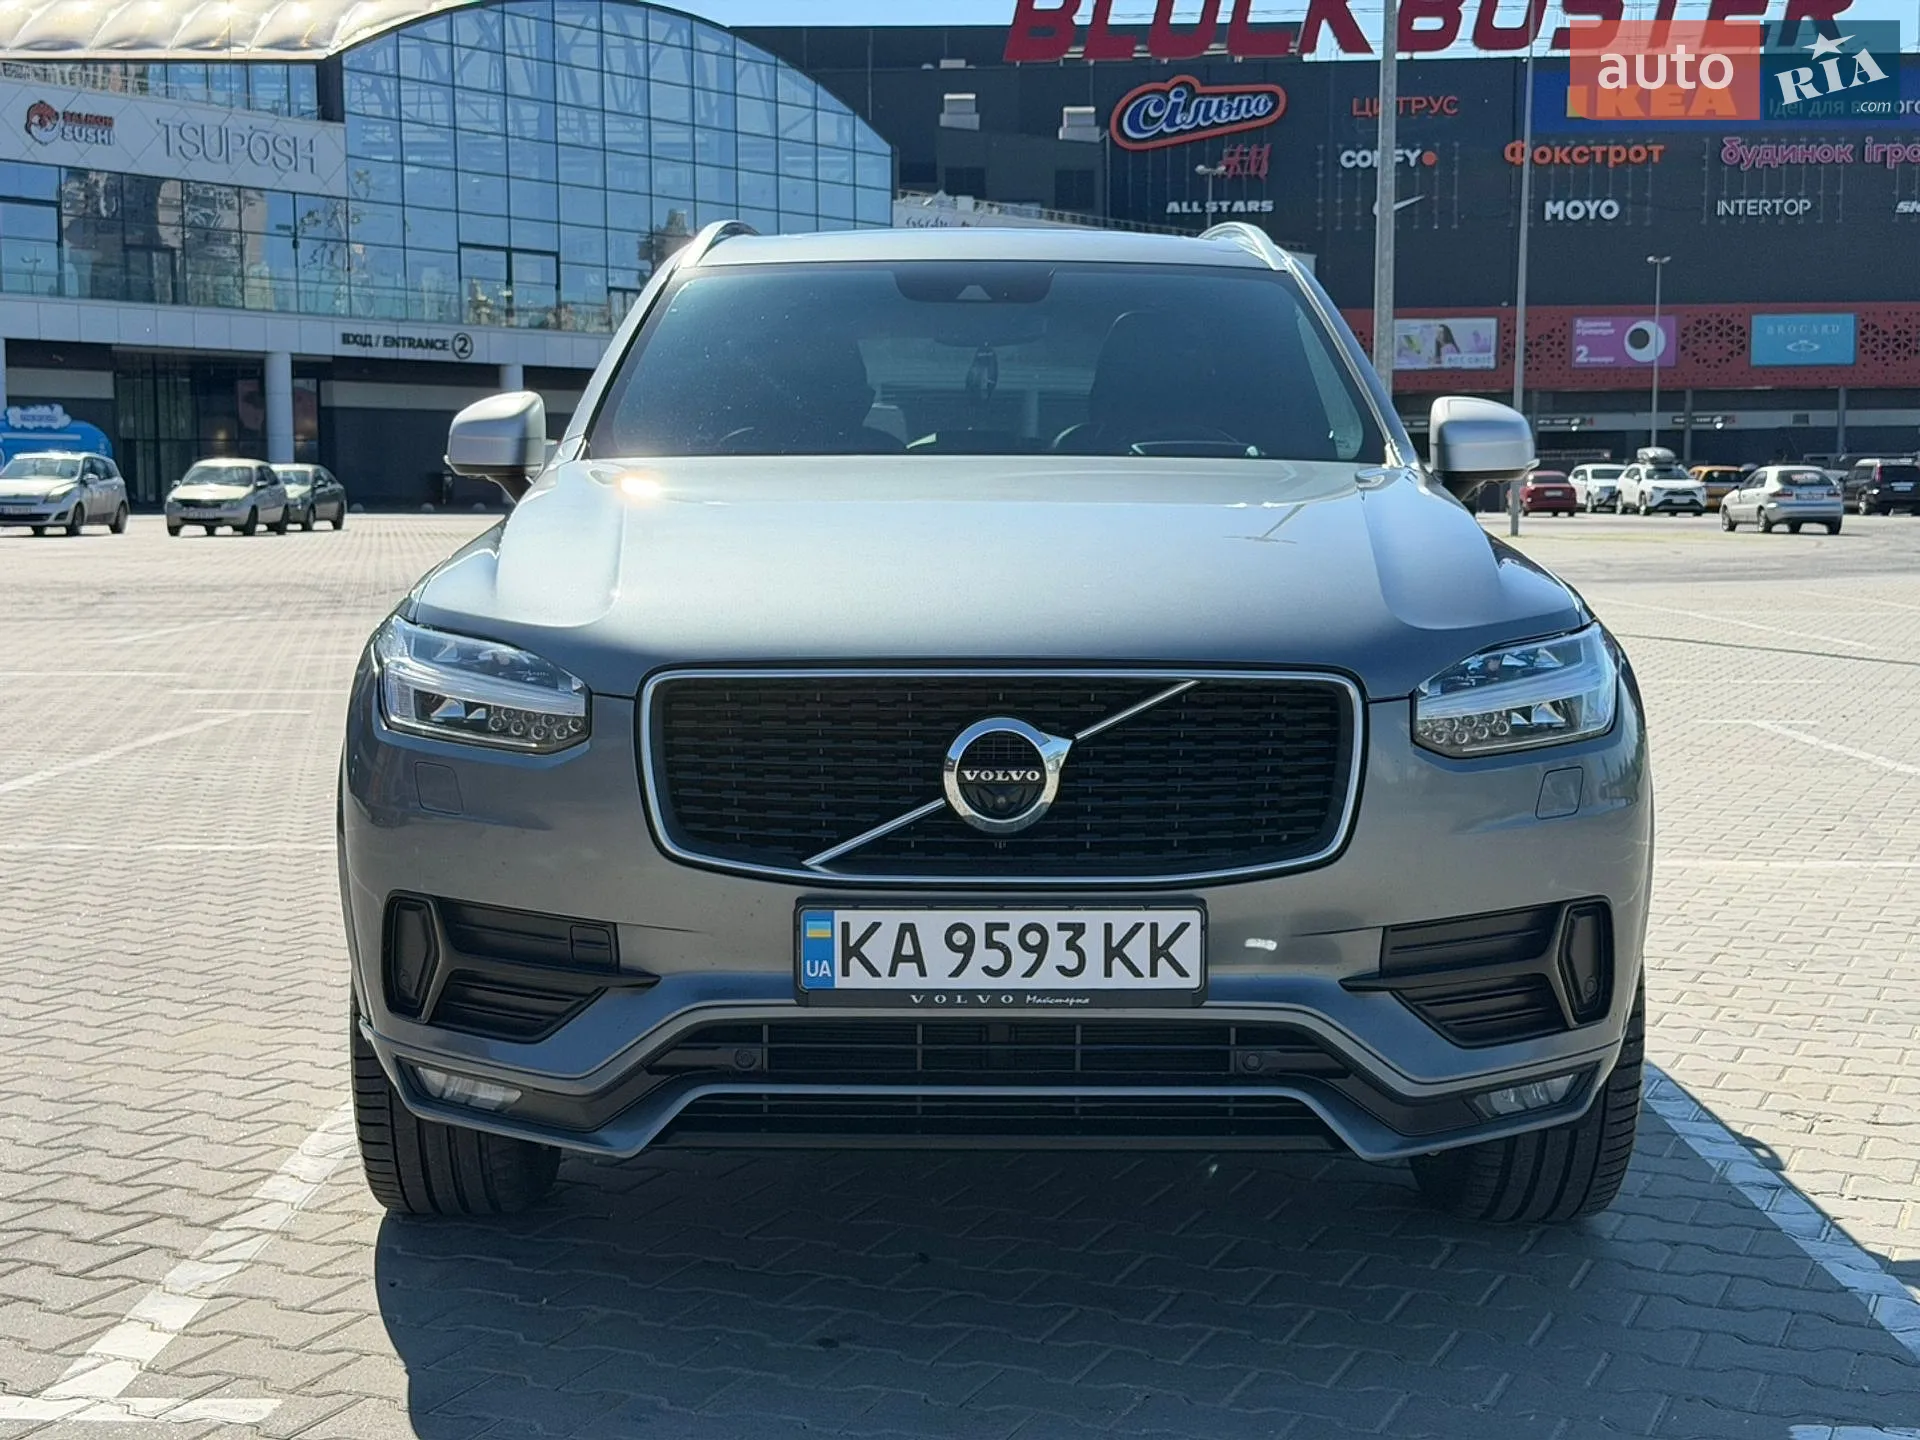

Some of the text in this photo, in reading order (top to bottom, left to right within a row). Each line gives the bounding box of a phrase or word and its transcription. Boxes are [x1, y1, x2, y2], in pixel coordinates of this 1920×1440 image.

[1567, 85, 1738, 118] IKEA
[1122, 87, 1274, 139] Сільпо
[61, 125, 116, 146] SUSHI
[1504, 139, 1665, 168] Фокстрот
[1720, 136, 1854, 171] будинок
[1166, 200, 1274, 214] ALL STARS
[1544, 199, 1621, 221] MOYO
[1717, 200, 1812, 217] INTERTOP
[383, 335, 450, 351] ENTRANCE
[1576, 345, 1589, 363] 2
[961, 769, 1041, 782] VOLVO
[840, 921, 1192, 978] KA 9593 KK
[806, 960, 832, 978] UA
[910, 994, 1014, 1004] VOLVO
